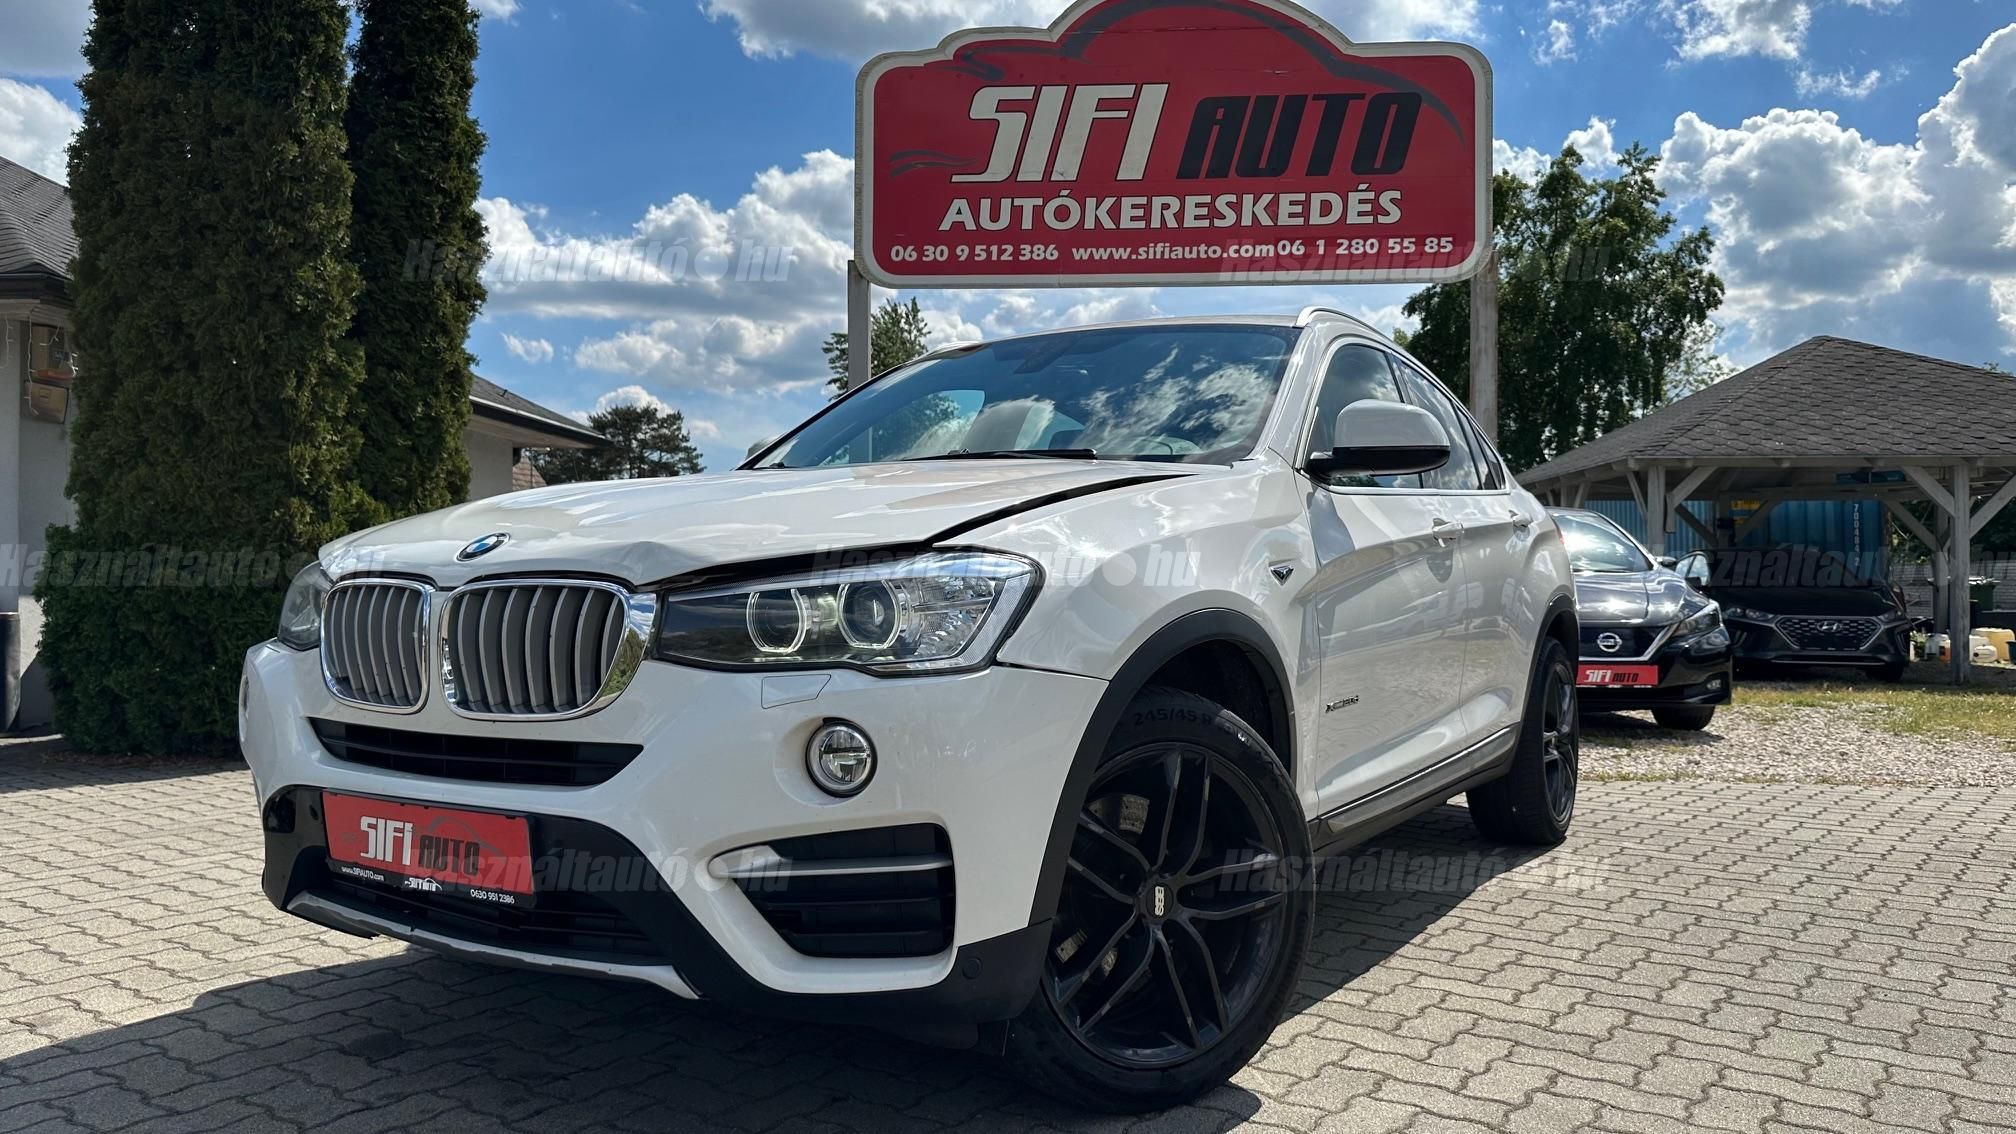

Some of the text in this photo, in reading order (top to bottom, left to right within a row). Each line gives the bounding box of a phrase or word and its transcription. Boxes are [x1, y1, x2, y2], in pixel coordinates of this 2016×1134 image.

[949, 83, 1423, 184] SIFI AUTO
[938, 183, 1404, 231] AUTÓKERESKEDÉS
[890, 245, 917, 262] 06
[922, 245, 949, 262] 30
[1018, 244, 1059, 261] 386
[1072, 242, 1274, 261] www.sifiauto.com
[1277, 237, 1454, 256] 06 1 280 55 85
[418, 834, 481, 877] AUTO
[1154, 885, 1165, 916] BBS
